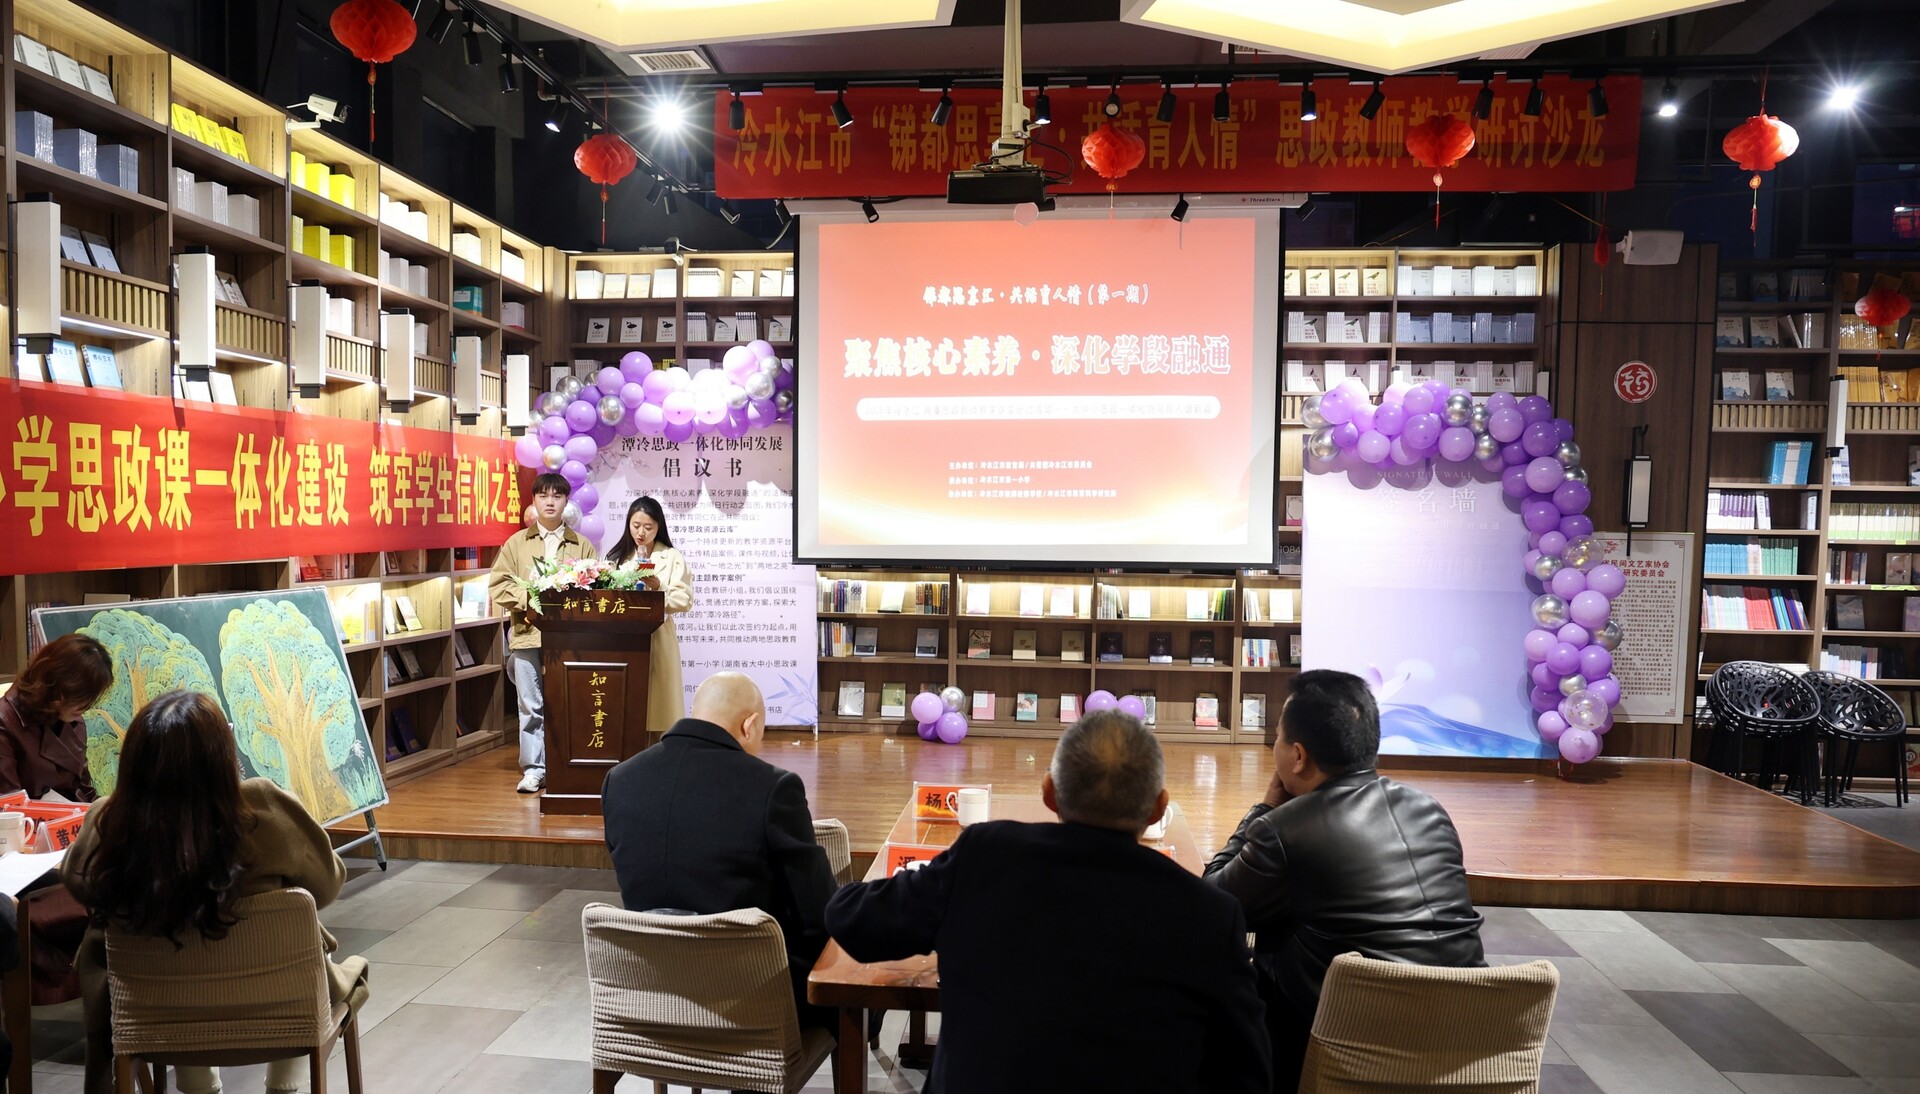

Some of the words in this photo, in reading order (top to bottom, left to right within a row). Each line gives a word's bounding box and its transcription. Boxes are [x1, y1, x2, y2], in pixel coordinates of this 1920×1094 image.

[732, 106, 850, 176] 冷水江市
[1275, 94, 1605, 168] 思政教师研讨沙龙
[843, 335, 1231, 377] 聚焦核心素养·深化学段融通
[621, 436, 783, 451] 潭冷思政一体化协同发展
[662, 458, 743, 478] 倡议书
[1443, 471, 1472, 479] WALL
[0, 415, 350, 537] 学思政课一体化建设
[369, 445, 521, 527] 筑牢学生信仰之基
[687, 562, 796, 570] 现从“一地之光”到“两地之亮”。
[693, 587, 797, 595] 联合教研小组。我们倡议围绕
[675, 623, 797, 631] 成河。让我们以此次签约为起点，用
